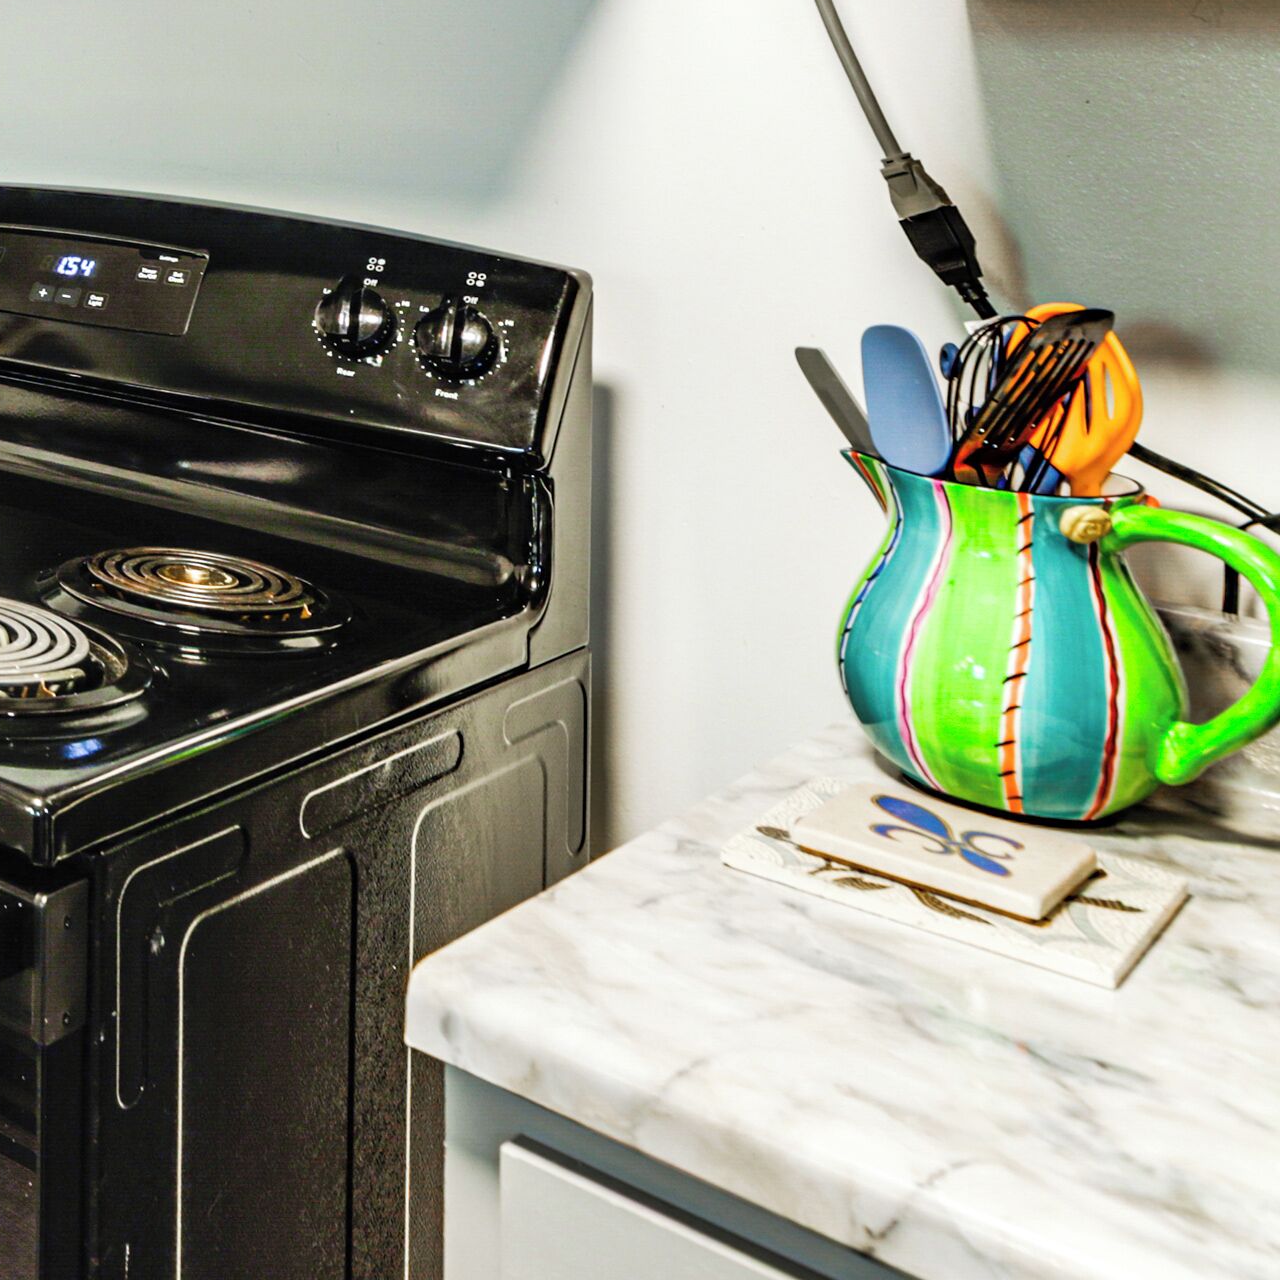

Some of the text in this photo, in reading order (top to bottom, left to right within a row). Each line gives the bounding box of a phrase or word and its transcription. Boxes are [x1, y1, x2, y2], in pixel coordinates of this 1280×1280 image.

[363, 278, 378, 287] Off
[463, 296, 479, 305] Off
[435, 388, 459, 400] Front
